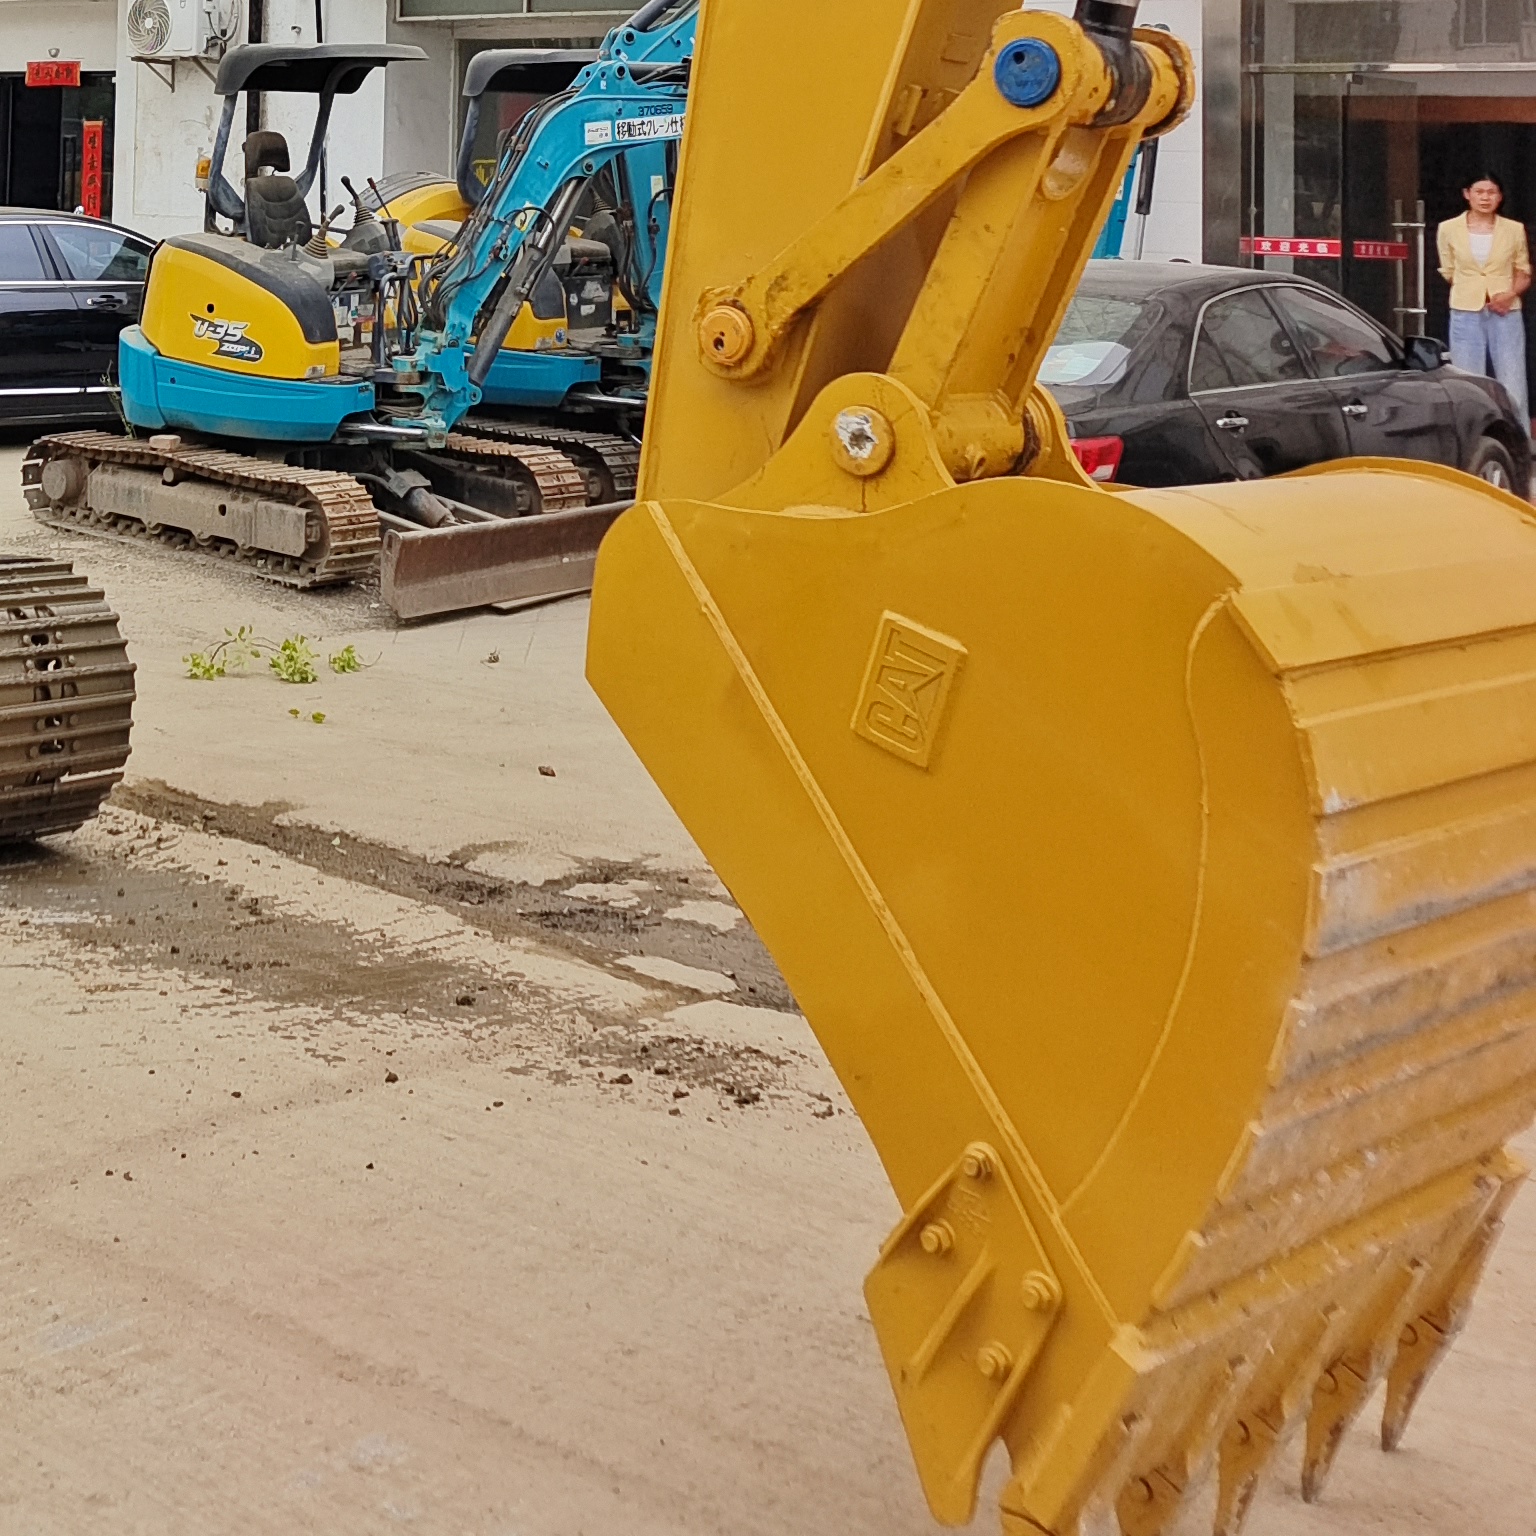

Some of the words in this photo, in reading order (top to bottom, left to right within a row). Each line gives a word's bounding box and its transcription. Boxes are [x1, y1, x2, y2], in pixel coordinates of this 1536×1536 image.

[1261, 241, 1329, 254] 欢迎光临
[865, 627, 948, 754] CAT
